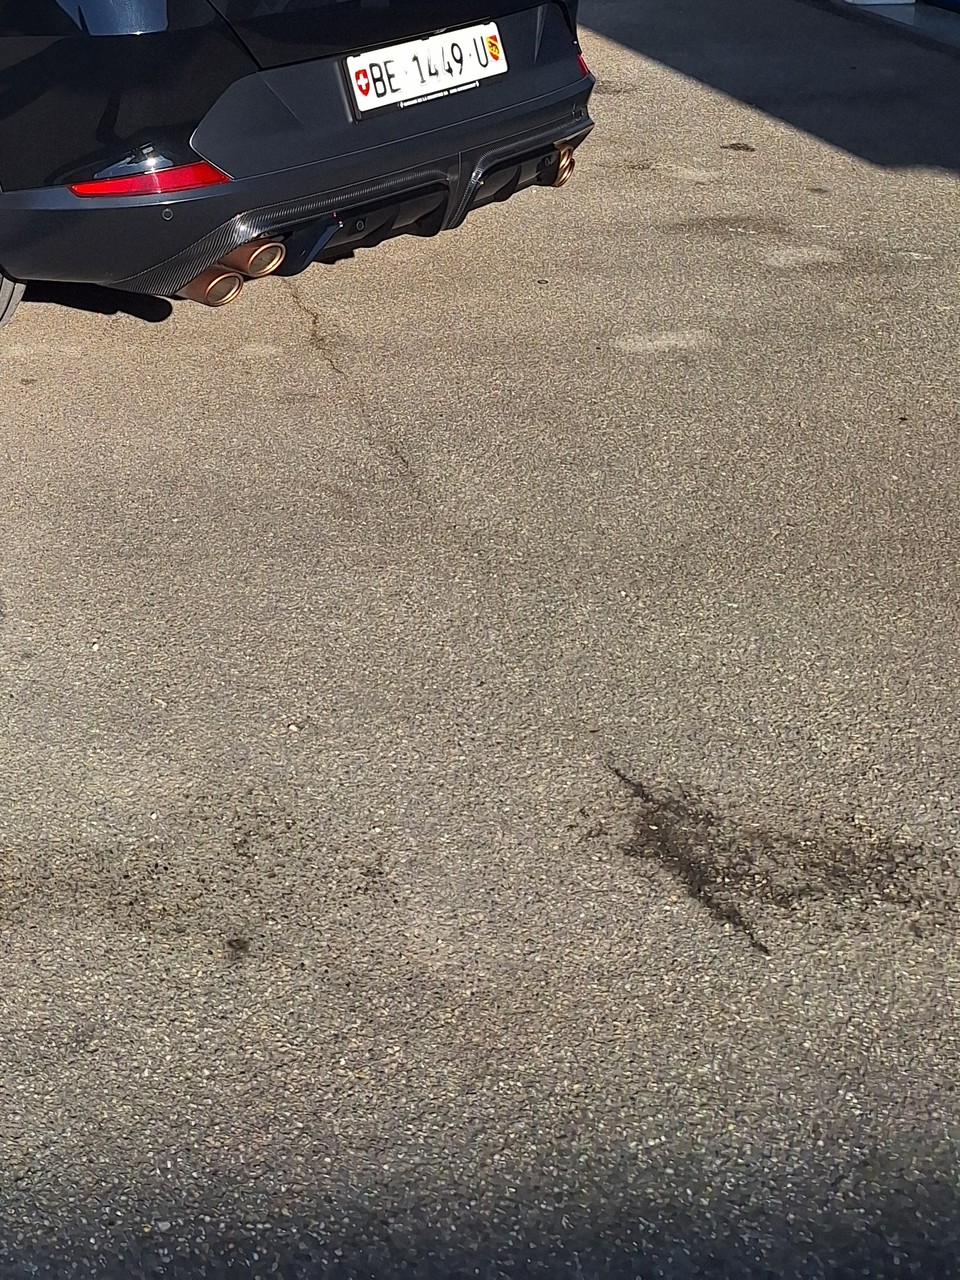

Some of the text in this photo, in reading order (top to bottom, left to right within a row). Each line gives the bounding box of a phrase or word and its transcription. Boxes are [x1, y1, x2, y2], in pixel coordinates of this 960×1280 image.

[369, 35, 489, 98] BE 1449 U
